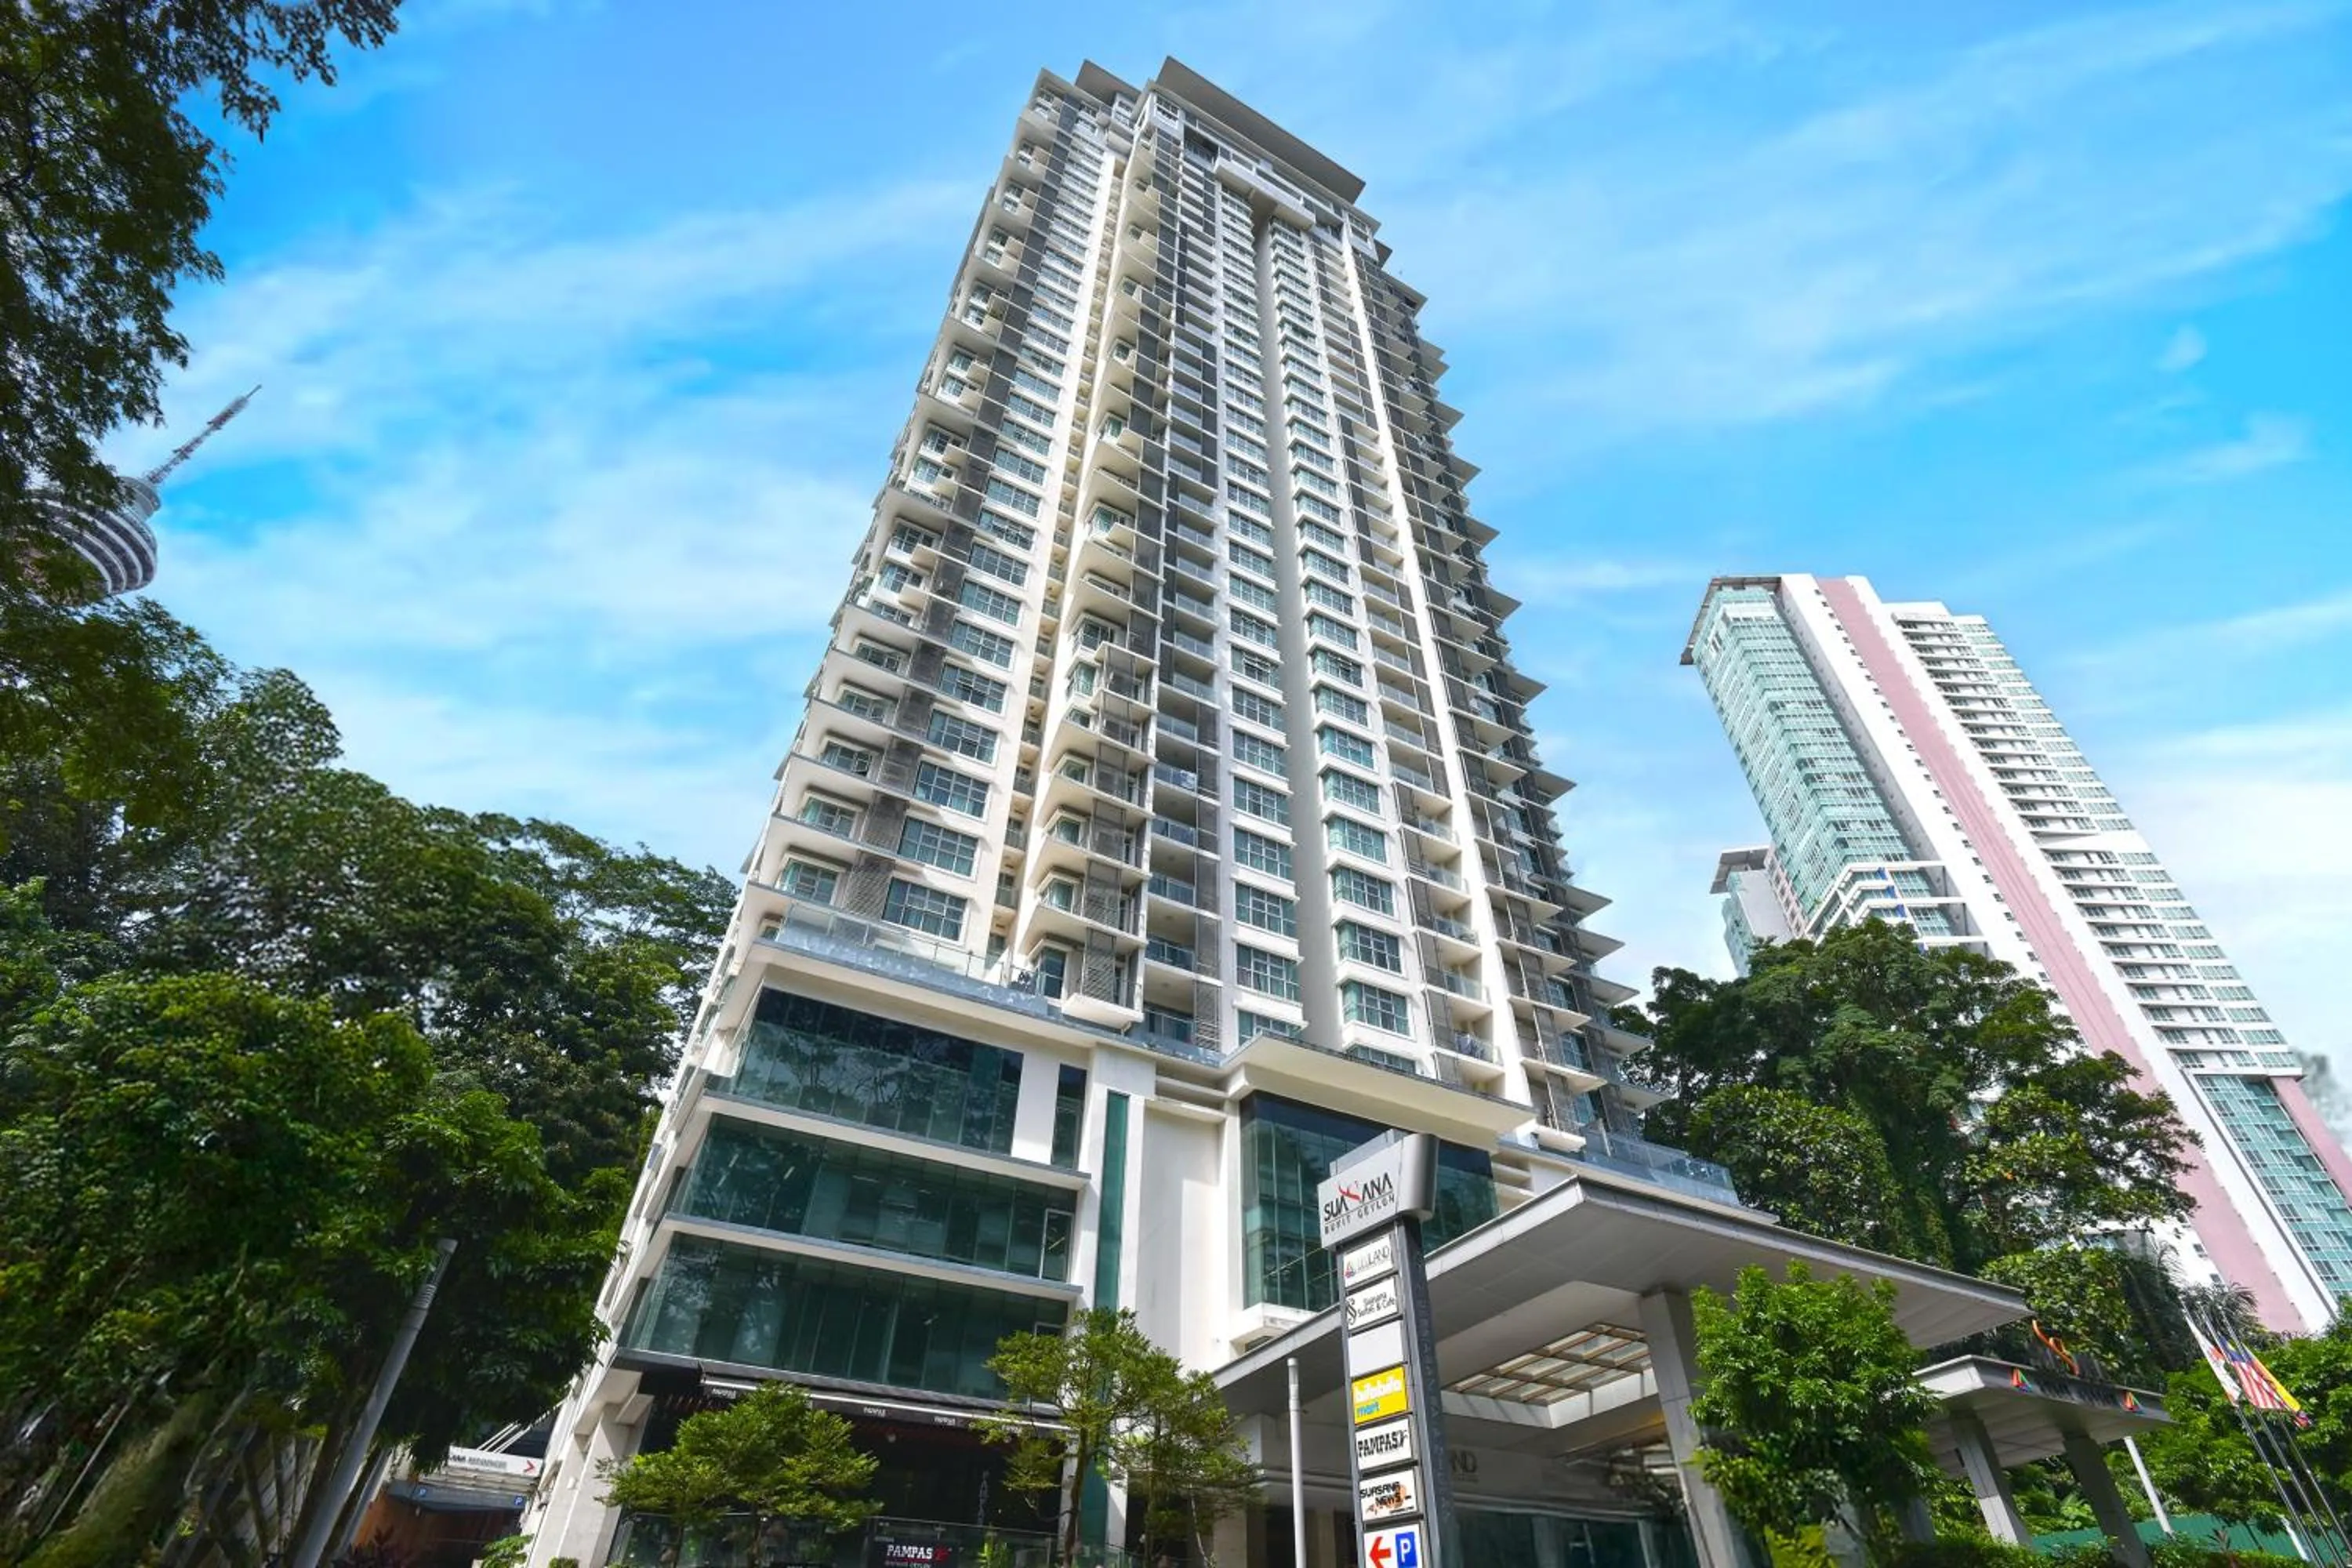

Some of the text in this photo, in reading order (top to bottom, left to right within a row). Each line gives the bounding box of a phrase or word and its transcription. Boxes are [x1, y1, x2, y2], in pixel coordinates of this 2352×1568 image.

[1357, 1431, 1399, 1457] PAMPAS
[887, 1544, 933, 1559] PAMPAS
[1400, 1538, 1411, 1563] P
